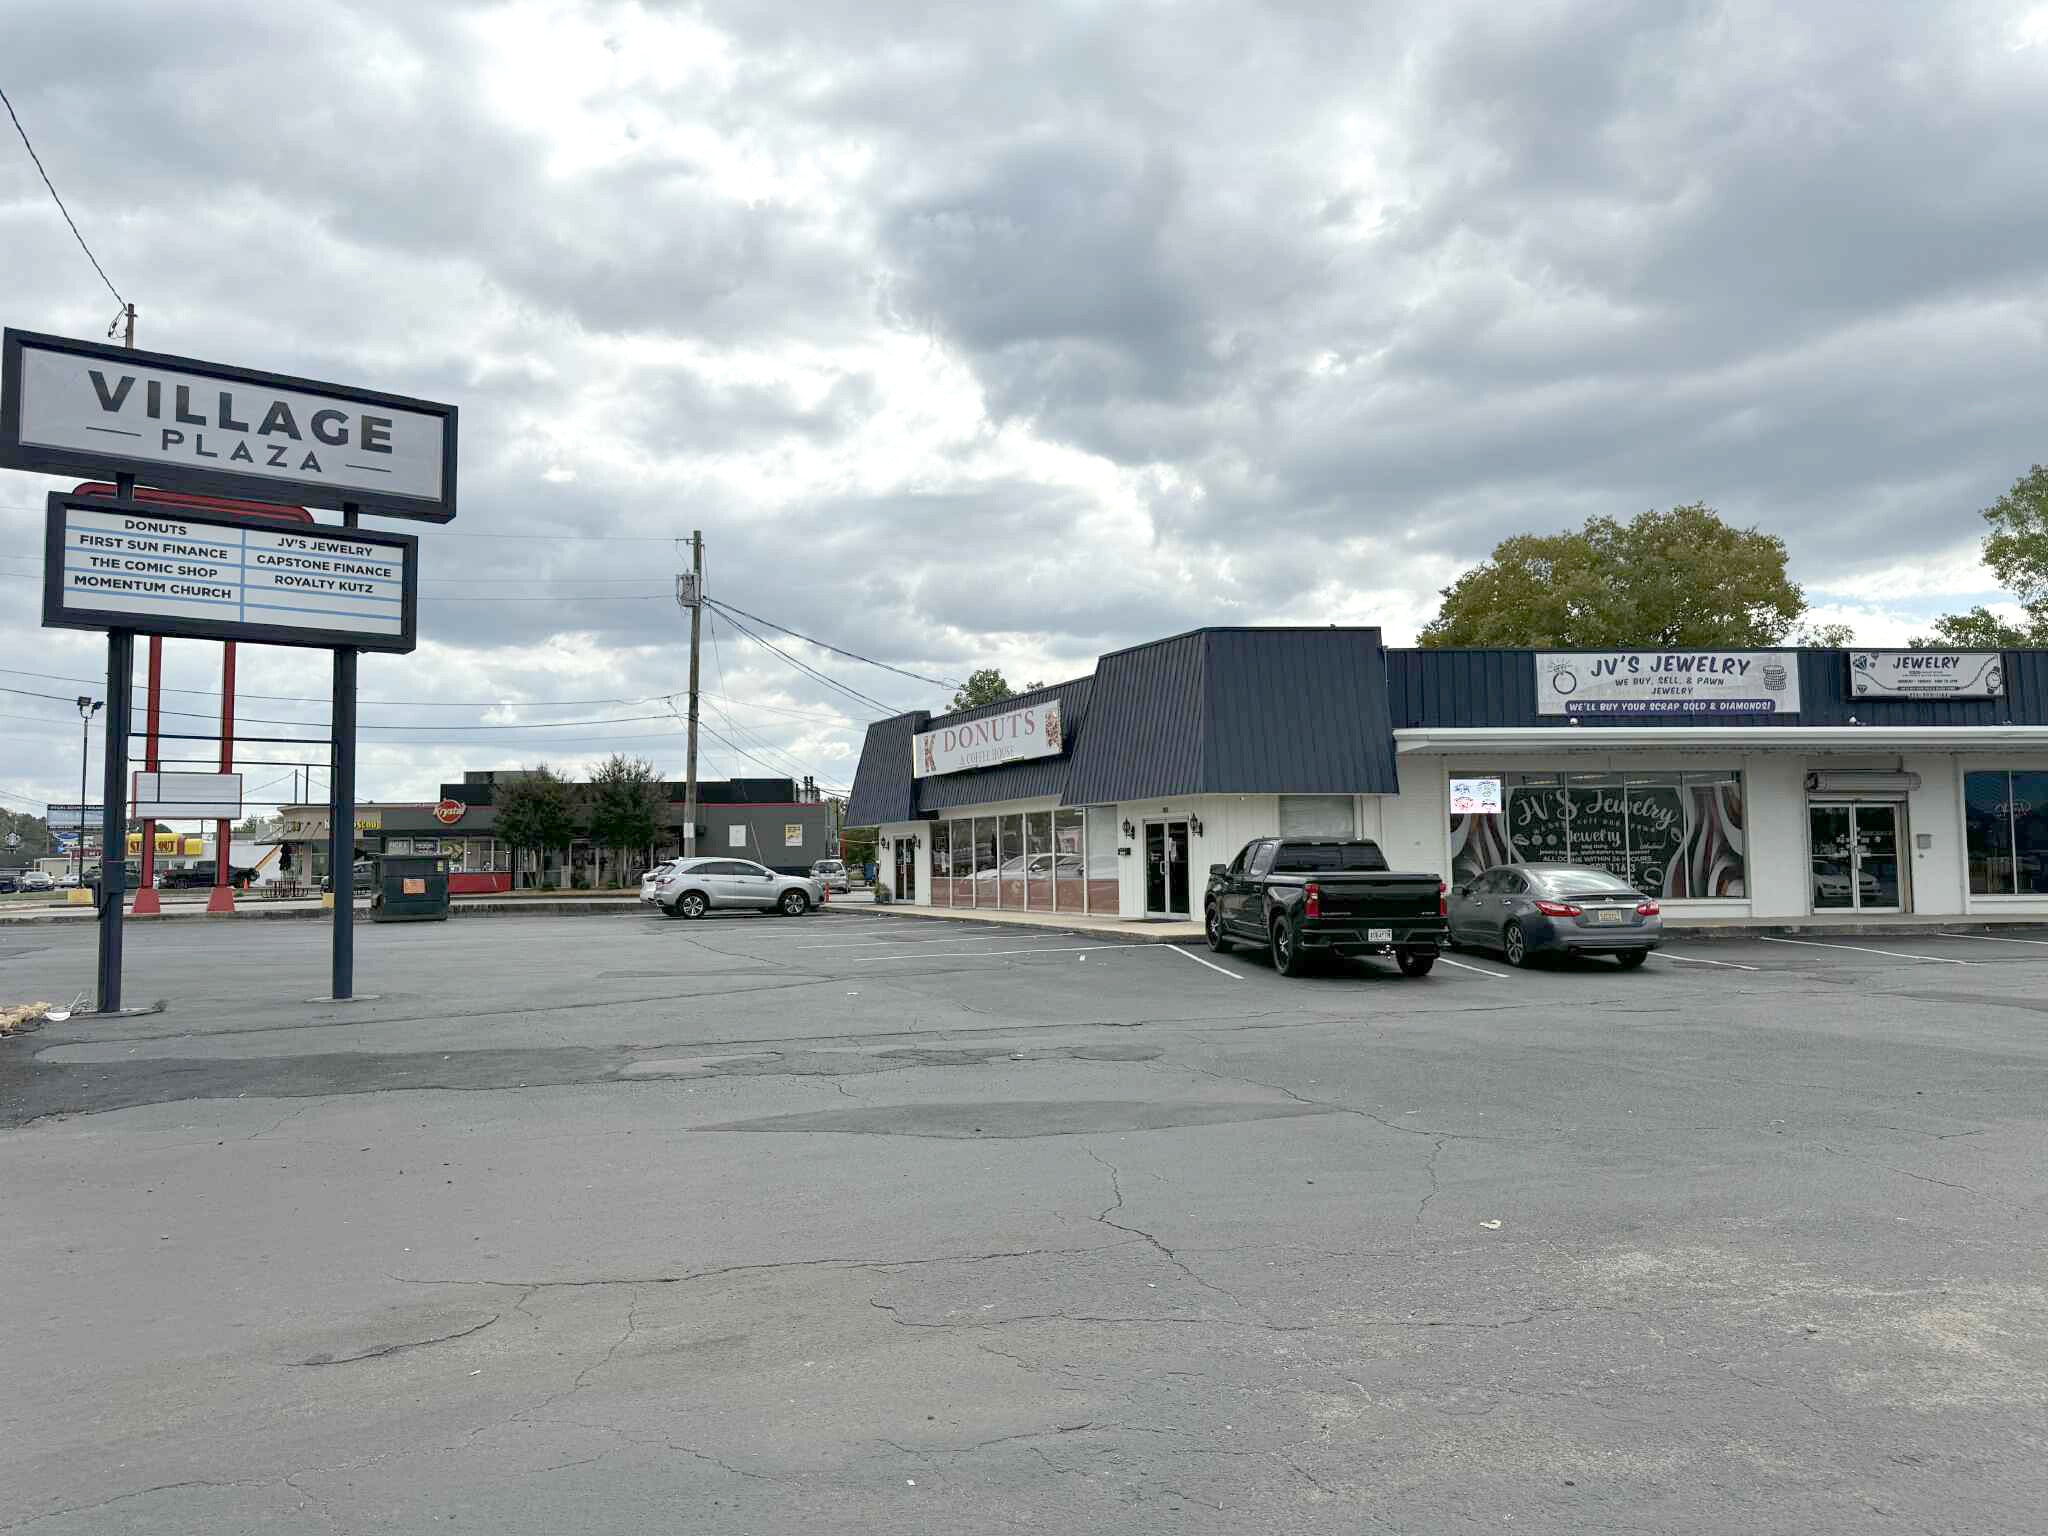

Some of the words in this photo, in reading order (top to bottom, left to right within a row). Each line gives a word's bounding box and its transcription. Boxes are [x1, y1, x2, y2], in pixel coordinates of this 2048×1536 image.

[87, 370, 393, 455] VILLAGE
[161, 428, 322, 473] PLAZA
[124, 519, 187, 536] DONUTS
[79, 534, 123, 549] FIRST
[127, 539, 159, 553] SUN
[162, 543, 228, 559] FINANCE
[277, 537, 307, 549] JV'S
[310, 541, 373, 557] JEWELRY
[89, 556, 121, 569] THE
[124, 560, 174, 574] COMIC
[177, 565, 218, 578] SHOP
[256, 554, 330, 571] CAPSTONE
[333, 562, 393, 578] FINANCE
[74, 575, 166, 593] MOMENTUM
[170, 584, 232, 599] CHURCH
[274, 575, 335, 590] ROYALTY
[339, 581, 374, 594] KUTZ
[1590, 655, 1640, 677] JV'S
[1650, 655, 1751, 676] JEWELRY
[1892, 656, 1960, 670] JEWELRY
[1615, 678, 1629, 687] WE
[1697, 676, 1725, 686] PAWN
[1651, 686, 1694, 696] JEWELRY
[1569, 702, 1597, 712] WE'LL
[1600, 702, 1618, 711] BUY
[1621, 702, 1647, 711] YOUR
[1650, 702, 1680, 711] SCRAP
[944, 710, 1036, 752] DONUTS
[432, 801, 467, 818] Krystal
[1586, 790, 1678, 829] Jewelry
